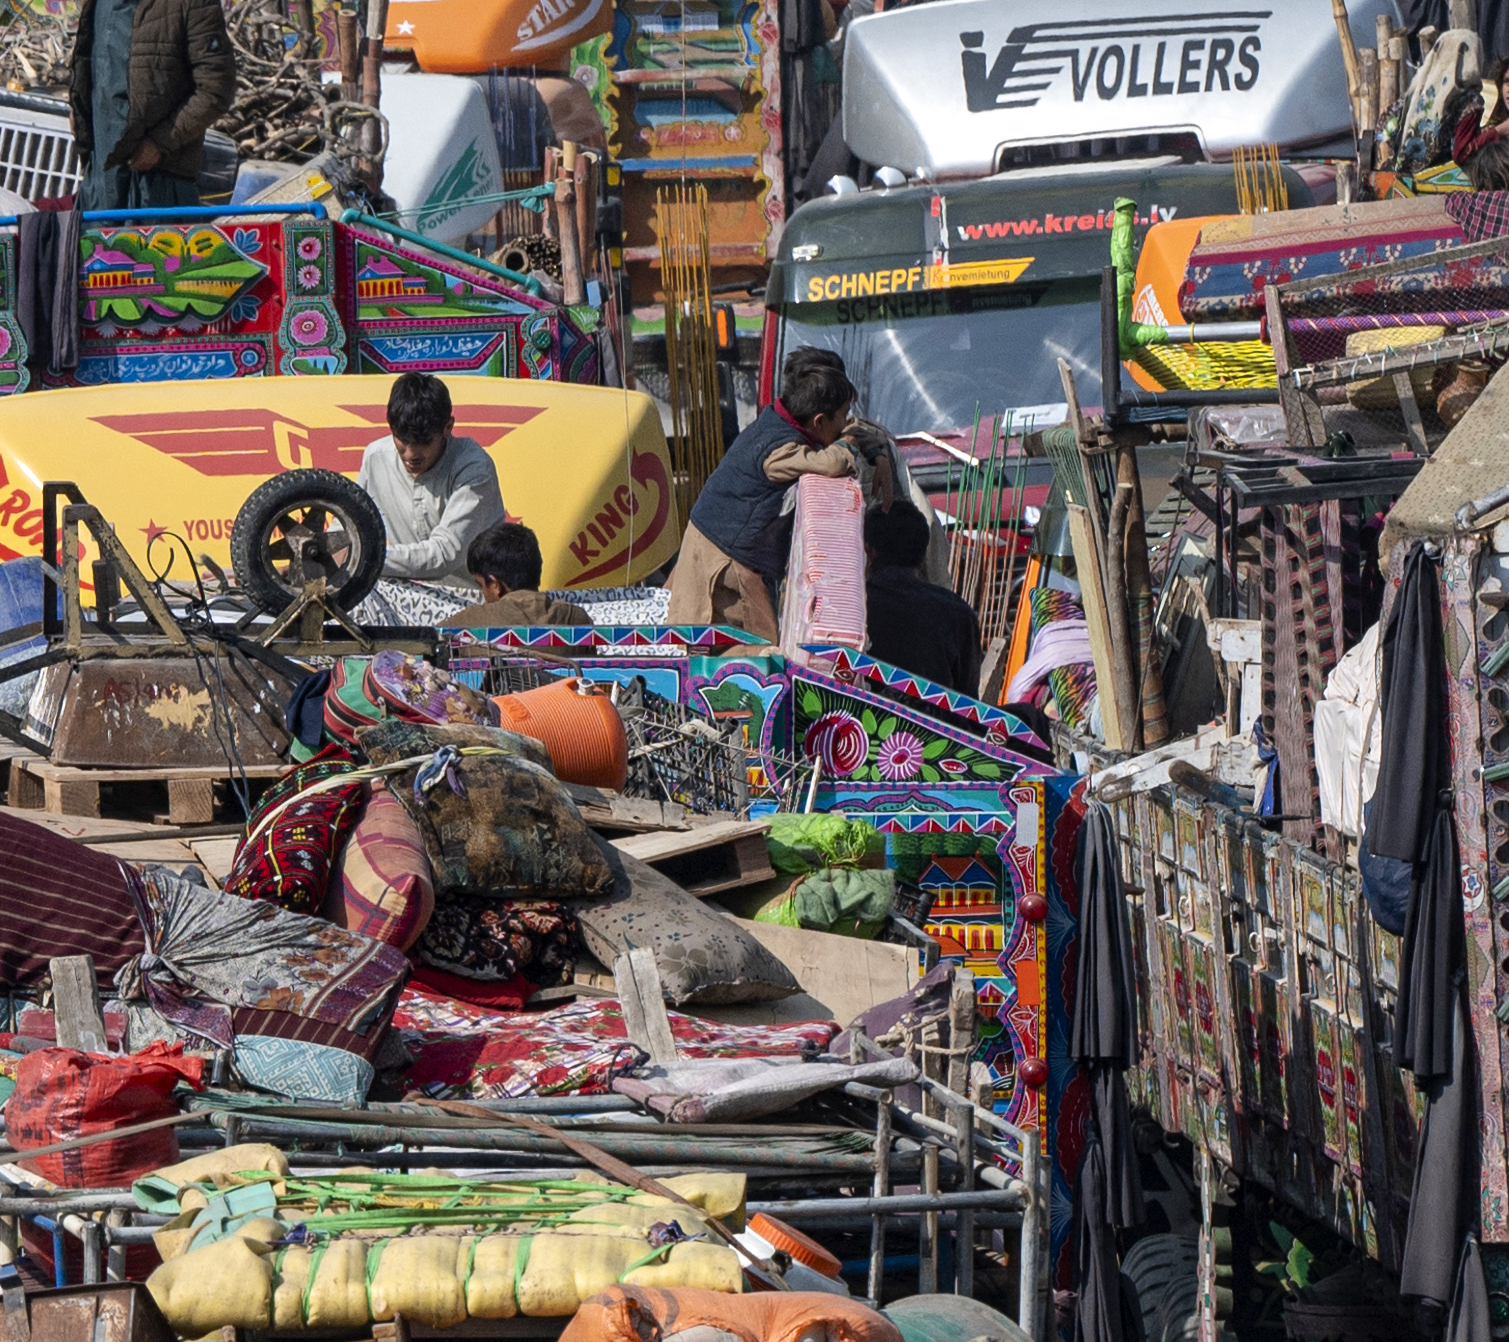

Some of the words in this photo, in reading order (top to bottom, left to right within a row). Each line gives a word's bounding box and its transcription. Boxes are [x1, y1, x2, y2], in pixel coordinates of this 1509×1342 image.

[1070, 35, 1262, 103] VOLLERS
[808, 267, 922, 302] SCHNEPF
[570, 484, 643, 566] KING
